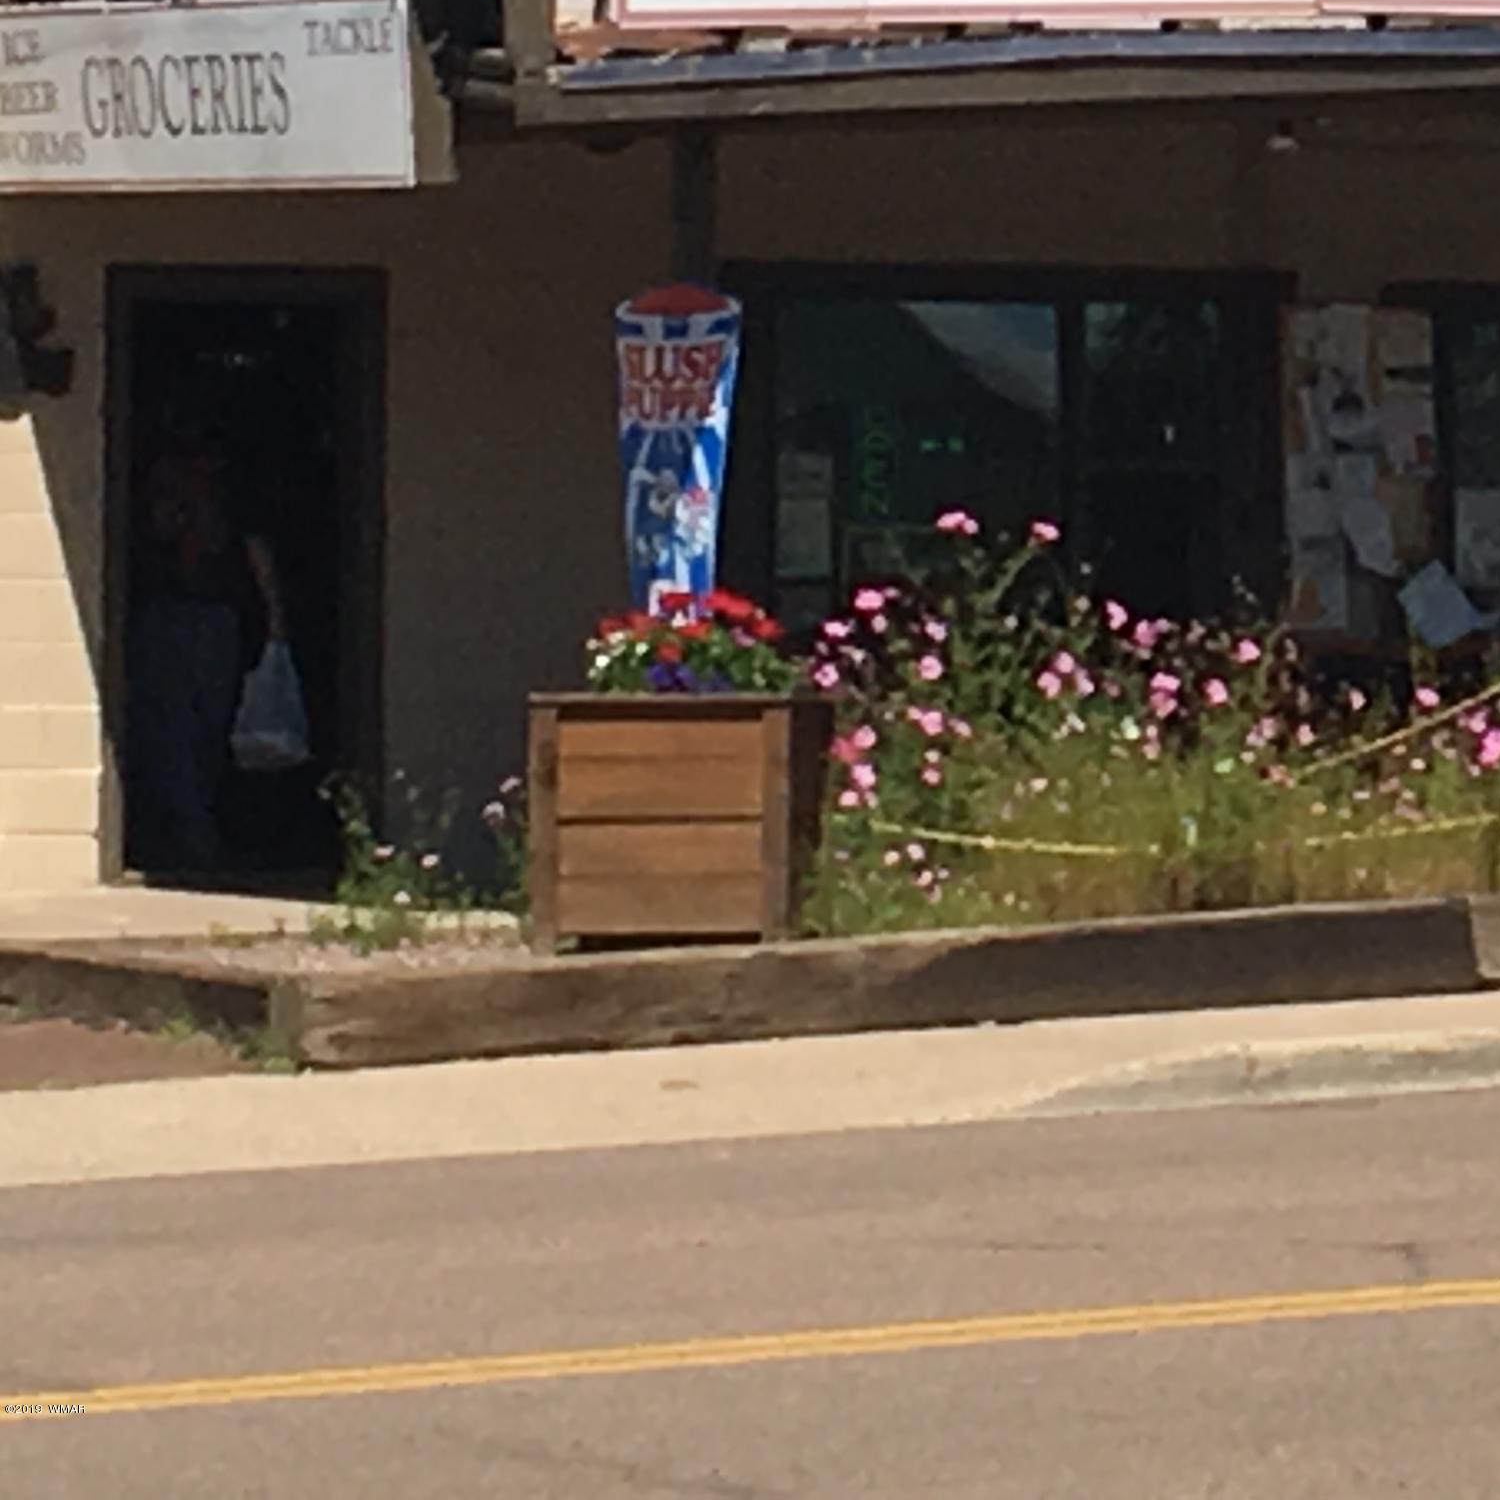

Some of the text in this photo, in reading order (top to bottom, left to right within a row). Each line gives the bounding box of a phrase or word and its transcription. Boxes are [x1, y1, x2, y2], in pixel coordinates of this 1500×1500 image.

[1, 28, 46, 67] ICE
[302, 17, 393, 57] TACKLE
[81, 51, 292, 139] GROCERIES
